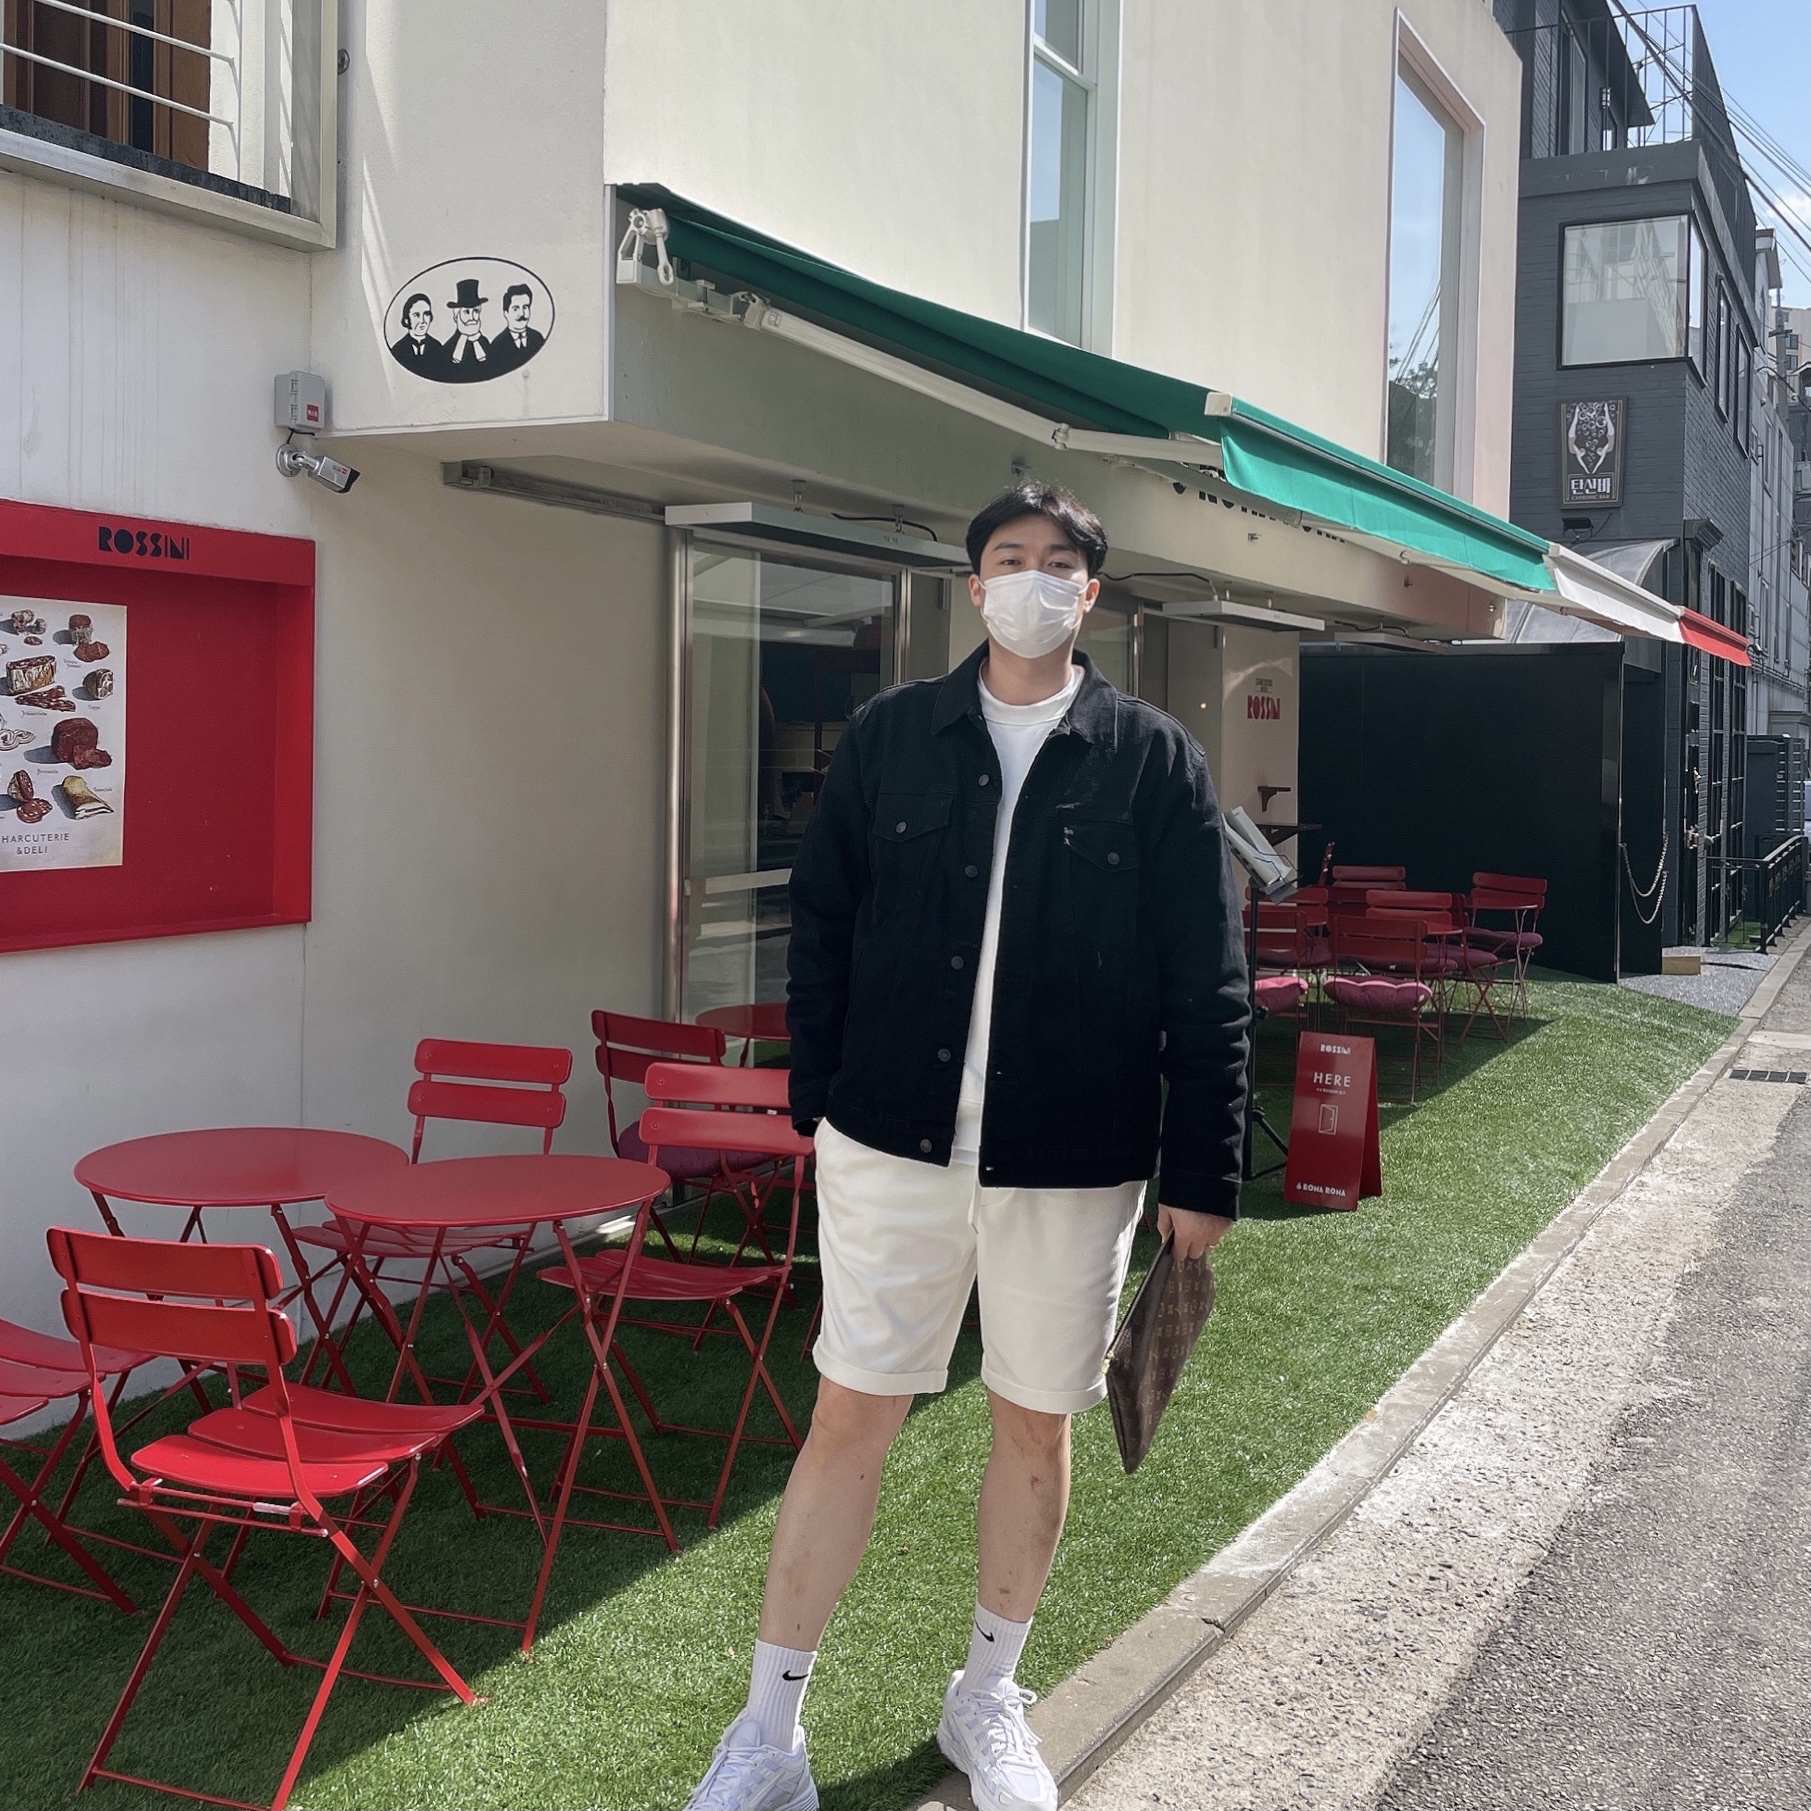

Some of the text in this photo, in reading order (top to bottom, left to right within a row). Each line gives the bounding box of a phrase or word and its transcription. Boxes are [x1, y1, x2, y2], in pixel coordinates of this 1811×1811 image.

[98, 526, 191, 561] ROSSINI
[16, 845, 48, 855] &DELI
[1313, 1071, 1352, 1088] HERE
